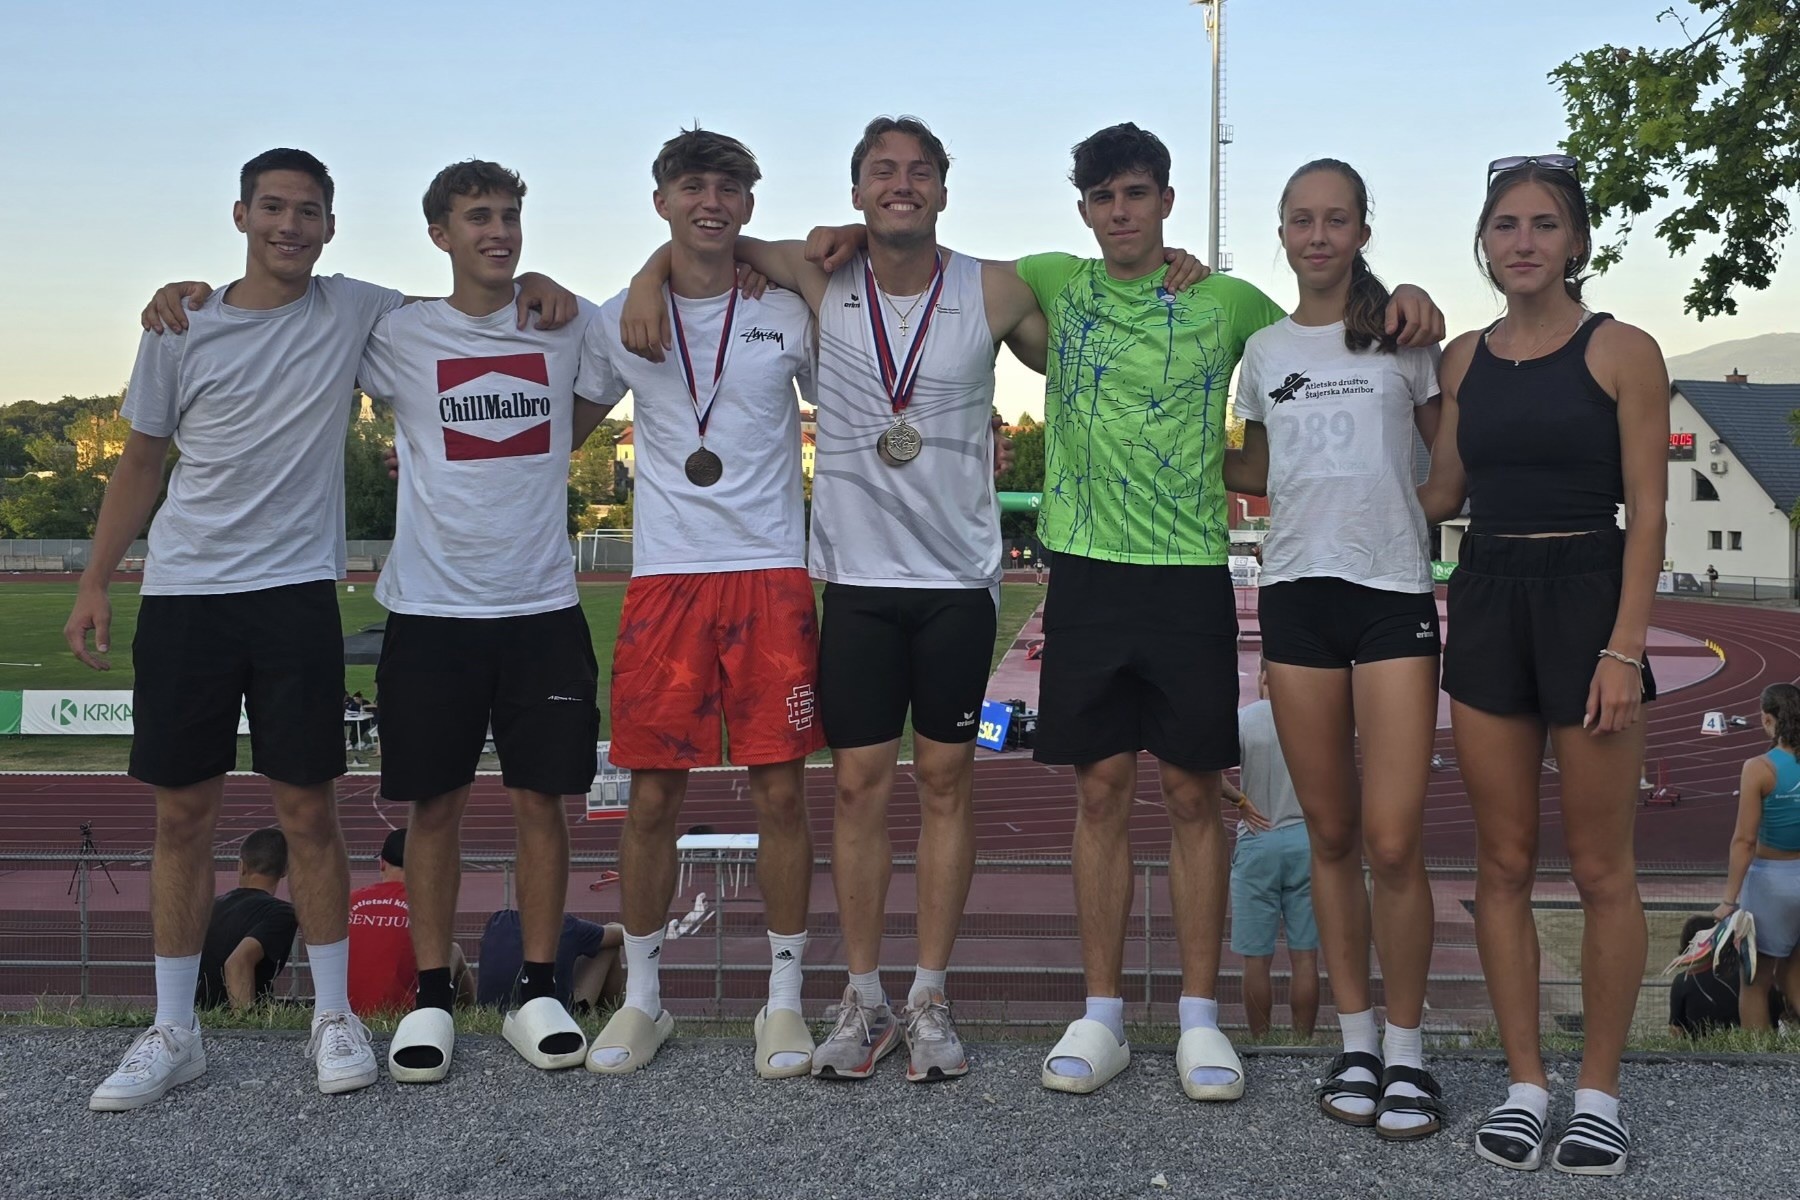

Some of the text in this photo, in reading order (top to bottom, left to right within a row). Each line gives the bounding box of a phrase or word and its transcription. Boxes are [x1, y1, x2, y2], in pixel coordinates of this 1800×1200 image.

[1305, 378, 1369, 391] Atletsko društvo
[1305, 386, 1374, 399] Štajerska Maribor
[439, 392, 551, 423] ChillMalbro
[1706, 717, 1716, 729] 4
[394, 898, 409, 910] klu
